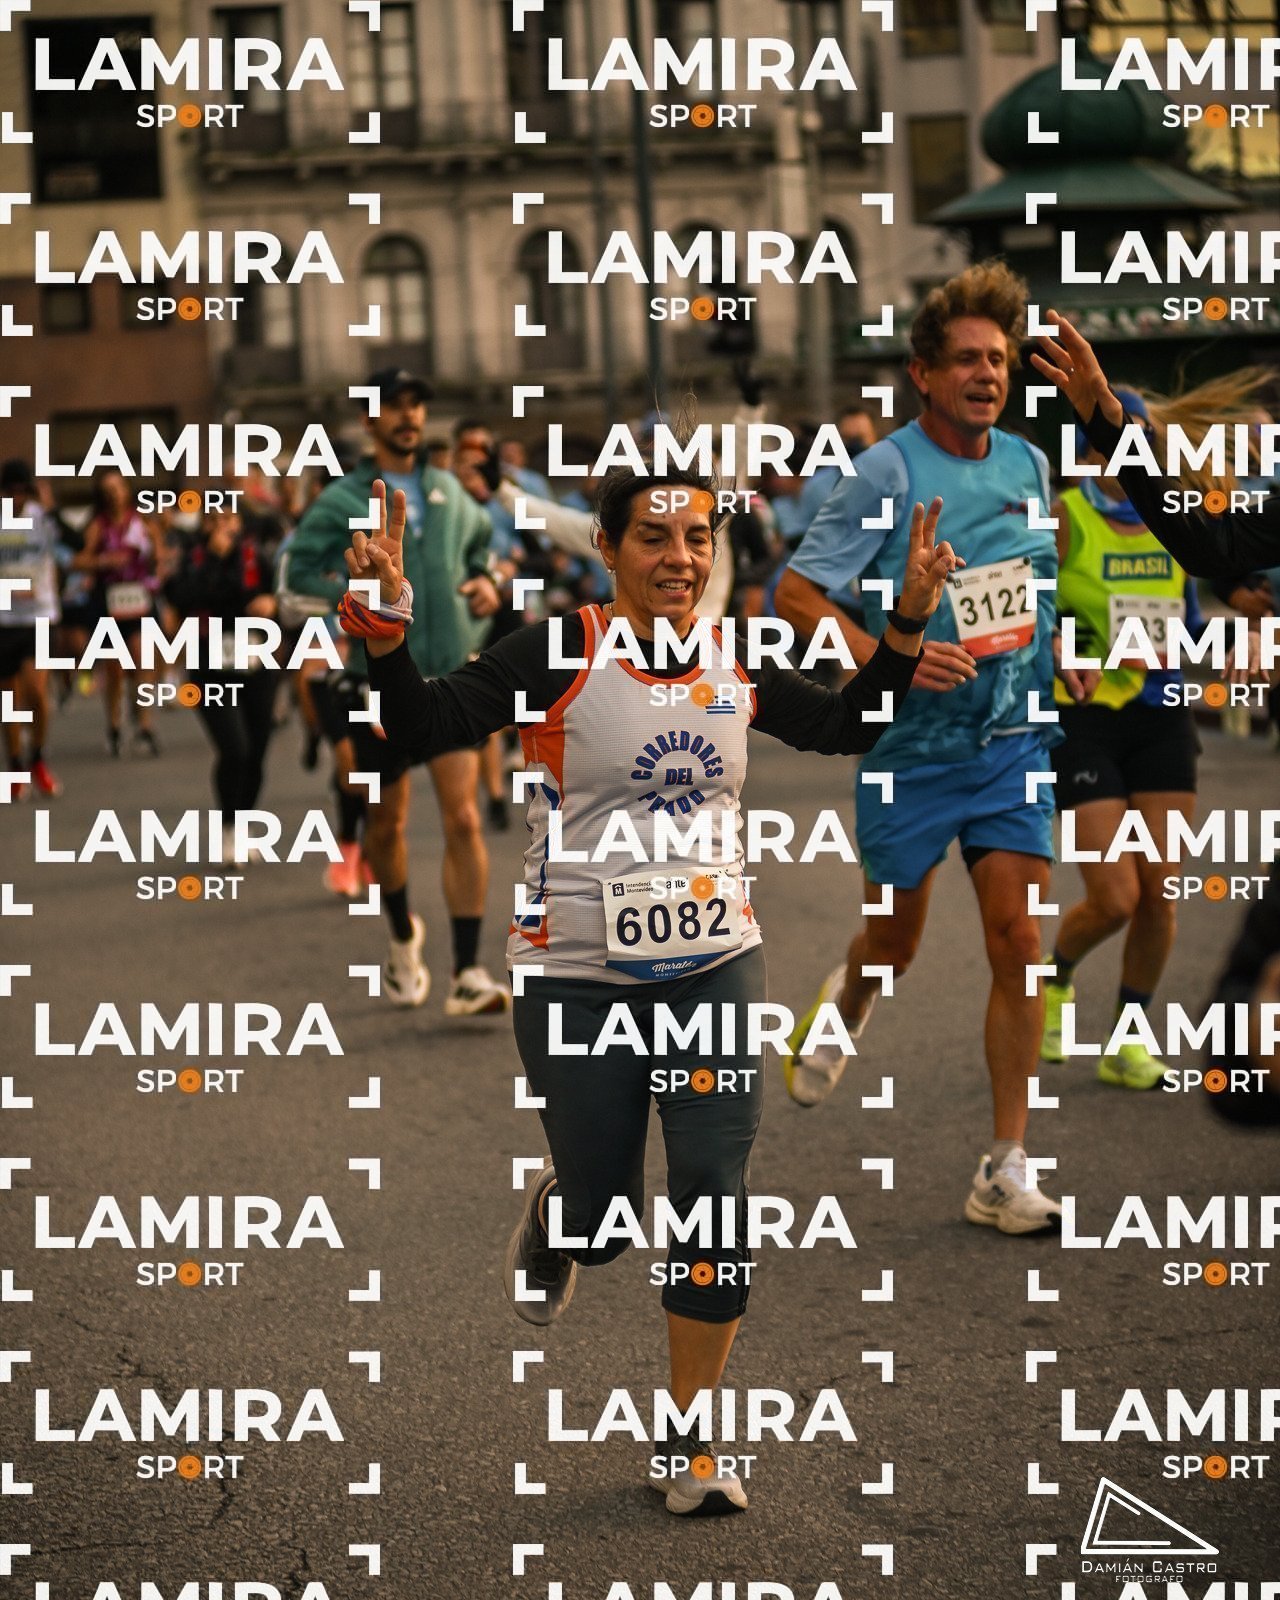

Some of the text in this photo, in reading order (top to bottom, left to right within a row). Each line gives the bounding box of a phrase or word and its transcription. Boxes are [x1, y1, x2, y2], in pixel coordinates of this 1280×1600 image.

[1108, 556, 1169, 577] BRASIL
[631, 730, 724, 780] CORREDORES
[664, 767, 694, 786] DEL
[616, 897, 731, 947] 6082
